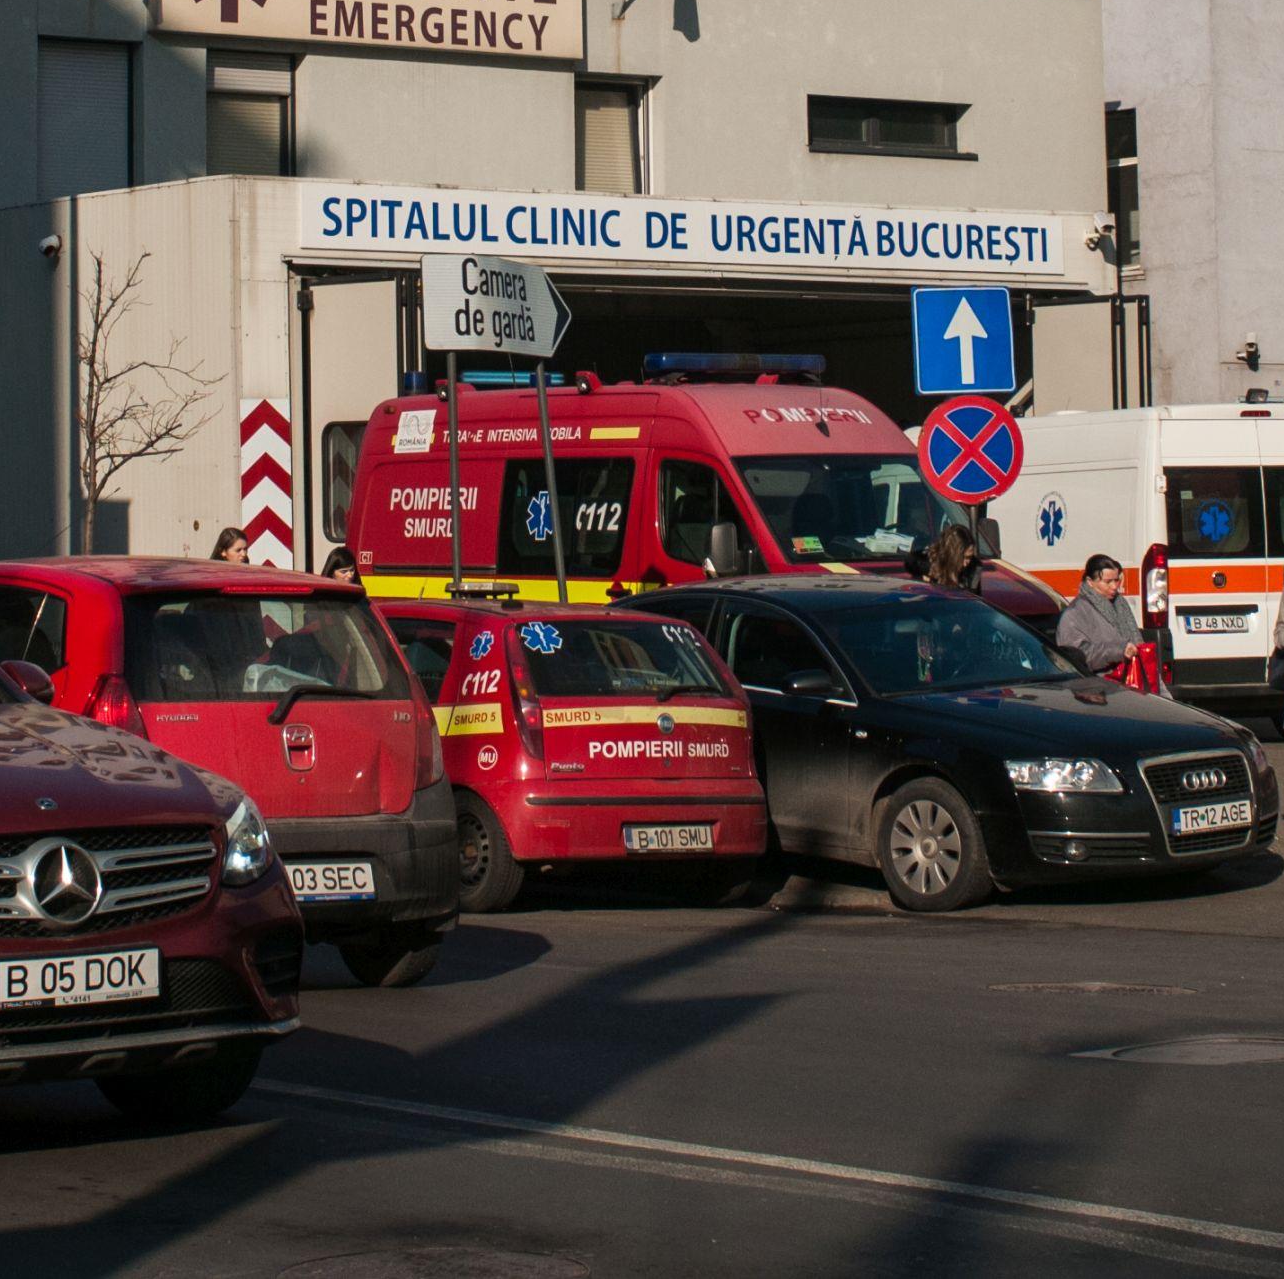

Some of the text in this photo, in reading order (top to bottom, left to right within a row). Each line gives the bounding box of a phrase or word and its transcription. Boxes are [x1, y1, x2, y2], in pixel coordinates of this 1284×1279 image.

[322, 197, 499, 243] SPITALUL
[506, 205, 621, 248] CLINIC
[646, 211, 689, 250] DE
[876, 221, 1048, 265] BUCUREȘTI
[461, 257, 528, 302] Camera
[454, 299, 536, 348] de gardă
[743, 408, 873, 424] POMPIERII
[487, 428, 538, 443] INTENSIVA
[549, 426, 581, 441] OBILA
[586, 503, 622, 532] 112
[1193, 617, 1202, 629] B
[472, 669, 501, 695] 112
[455, 712, 496, 725] SMURD 5
[546, 710, 591, 723] SMURD
[480, 752, 496, 764] MU
[589, 741, 729, 759] POMPIERII SMURD
[551, 762, 585, 770] Punto
[1182, 803, 1248, 829] TR 12 AGE
[638, 828, 708, 849] B 101 SMU
[293, 867, 367, 891] 03 SEC
[7, 965, 29, 999] B
[40, 961, 76, 995] 05
[85, 953, 147, 992] DOK
